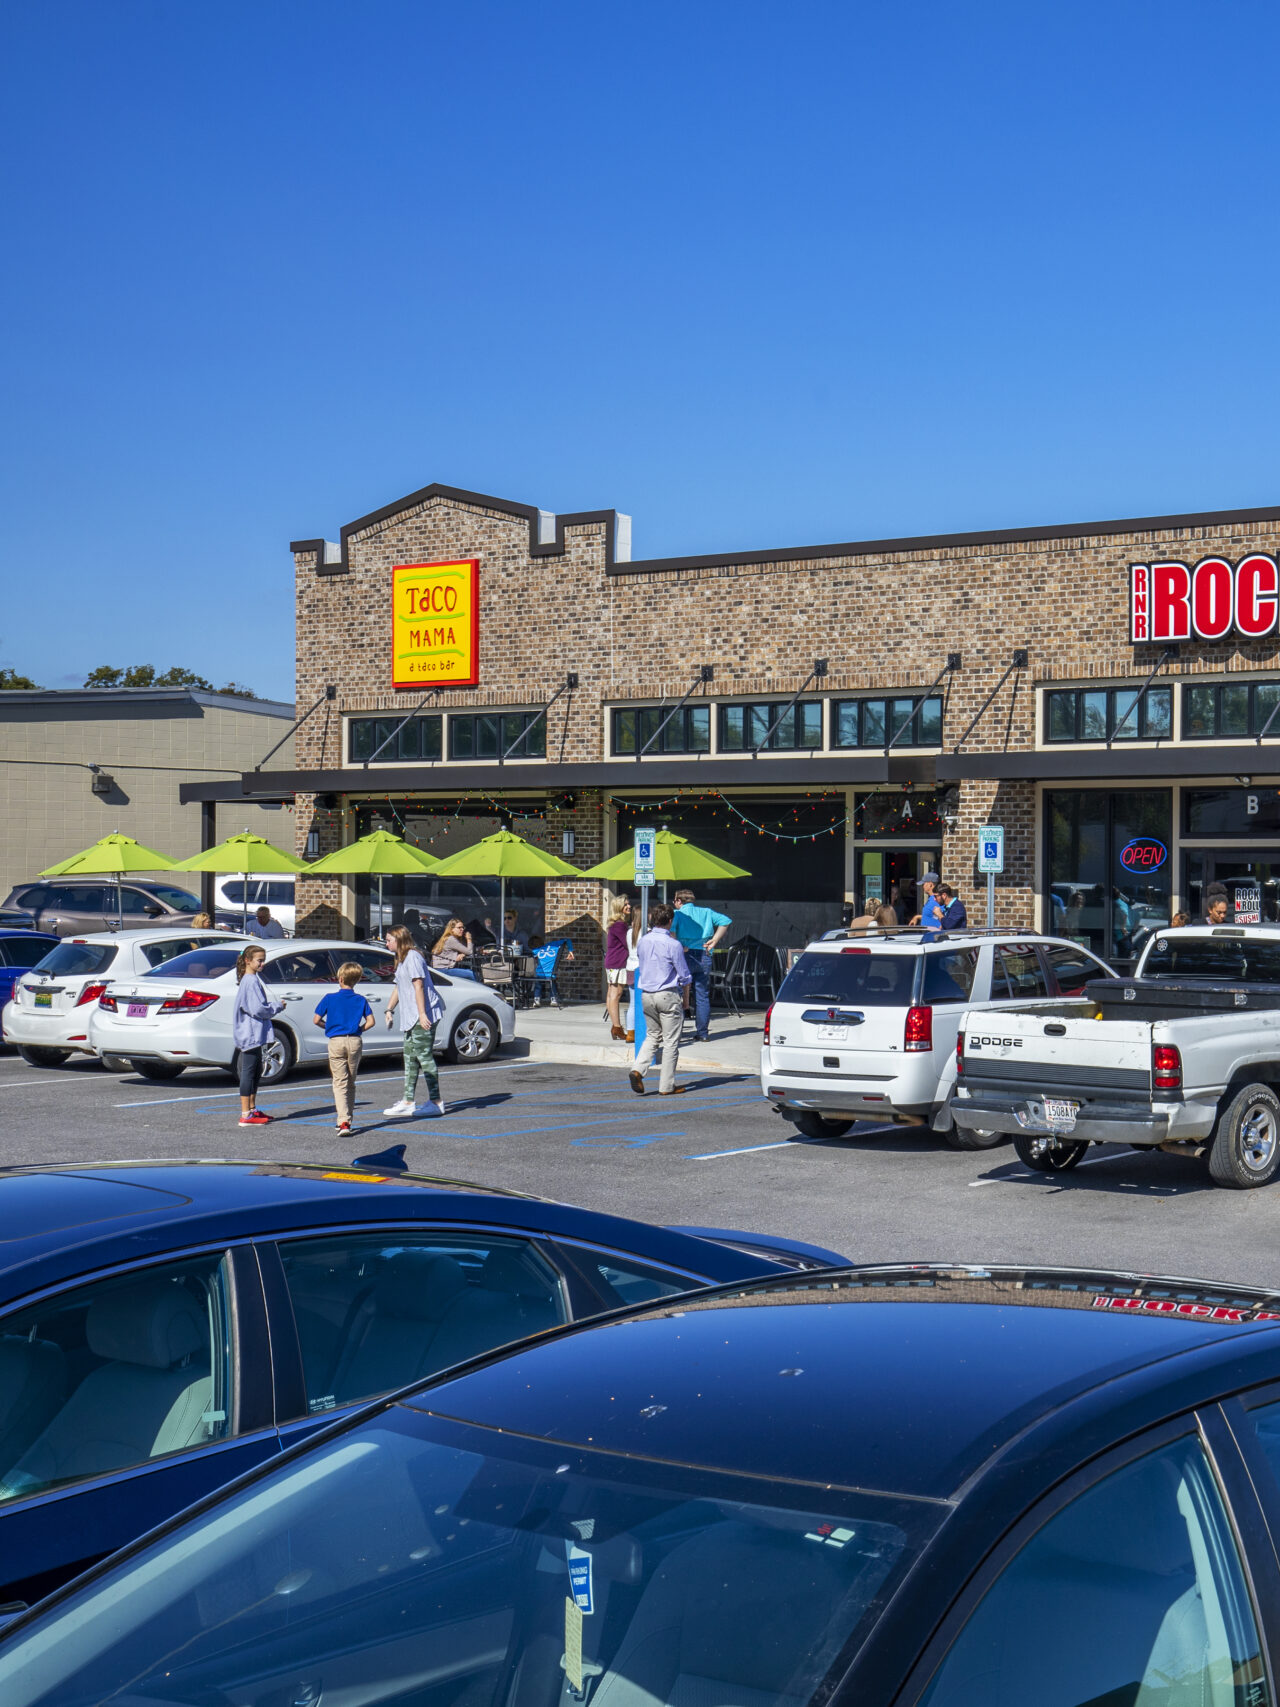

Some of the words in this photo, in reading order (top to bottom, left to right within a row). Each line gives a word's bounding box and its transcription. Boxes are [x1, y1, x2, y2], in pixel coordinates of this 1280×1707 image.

[1132, 566, 1149, 641] RNR
[410, 627, 456, 648] MAMA
[409, 663, 414, 672] a
[418, 662, 436, 672] taco
[440, 660, 455, 671] bar
[901, 800, 913, 817] A
[1247, 796, 1259, 814] B
[1122, 847, 1163, 864] OPEN
[1236, 888, 1260, 900] ROCK
[1242, 900, 1261, 911] ROLL
[1239, 912, 1259, 924] SUSHI
[970, 1036, 1023, 1047] DODGE
[570, 1566, 588, 1576] PARKING
[573, 1576, 587, 1586] PERMIT
